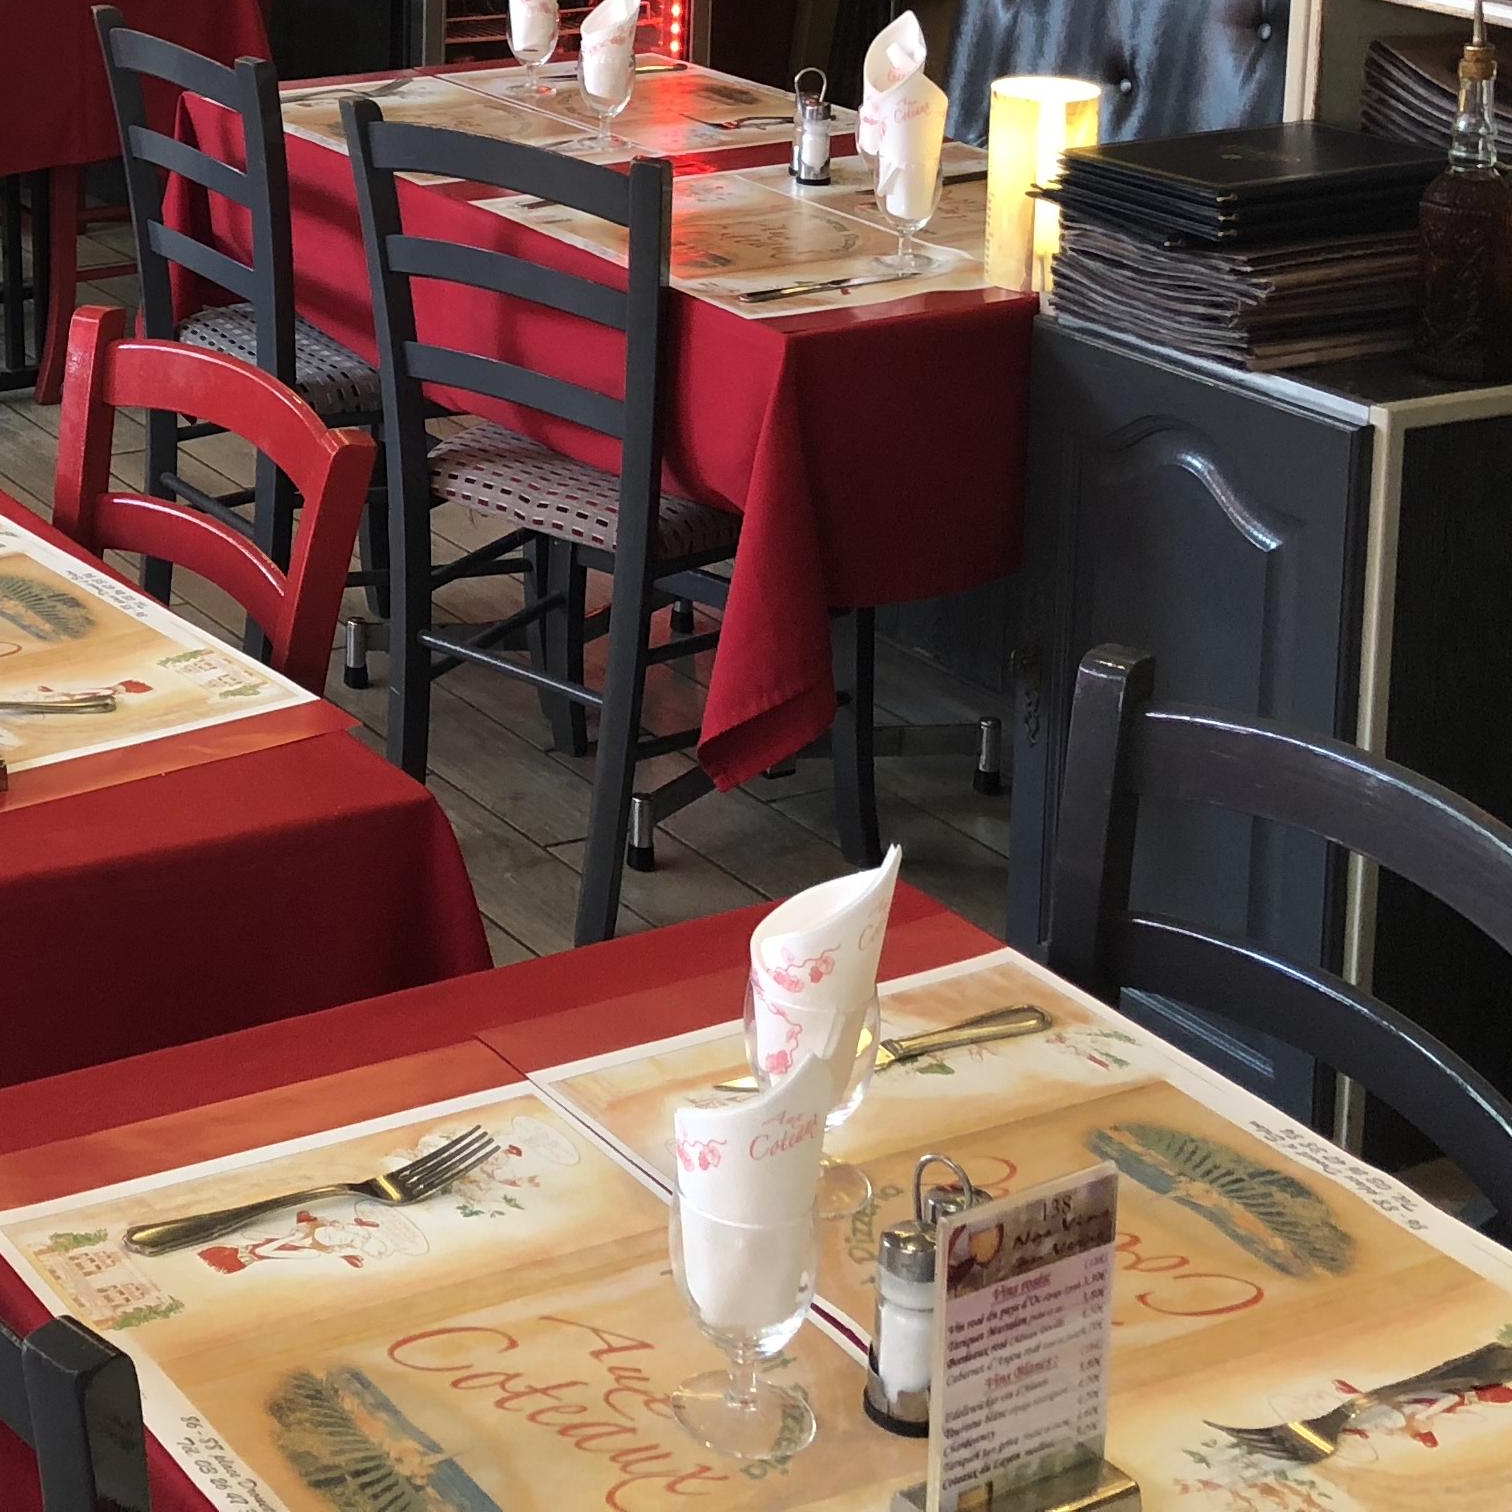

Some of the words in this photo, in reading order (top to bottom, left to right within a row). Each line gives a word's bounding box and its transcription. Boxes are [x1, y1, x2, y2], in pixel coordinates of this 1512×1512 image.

[1040, 1196, 1073, 1221] 138
[388, 1326, 730, 1512] Coteaux
[538, 1316, 675, 1421] Aux
